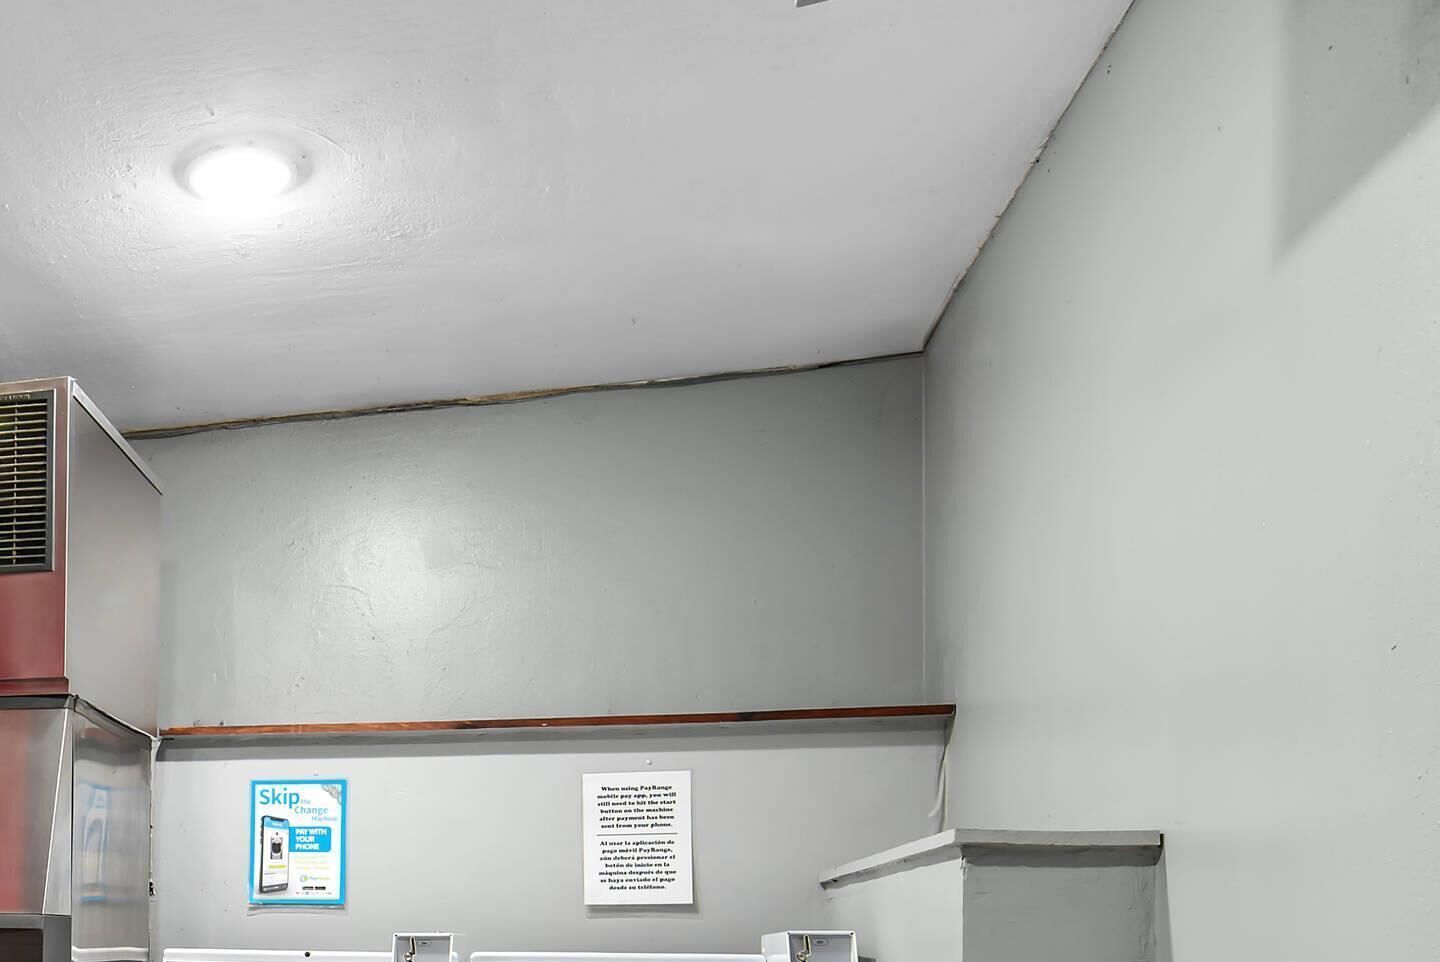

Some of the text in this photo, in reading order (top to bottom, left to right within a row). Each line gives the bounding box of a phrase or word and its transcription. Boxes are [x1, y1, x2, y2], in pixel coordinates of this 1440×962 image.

[259, 787, 300, 809] Skip
[294, 806, 328, 816] Change
[295, 835, 315, 843] YOUR
